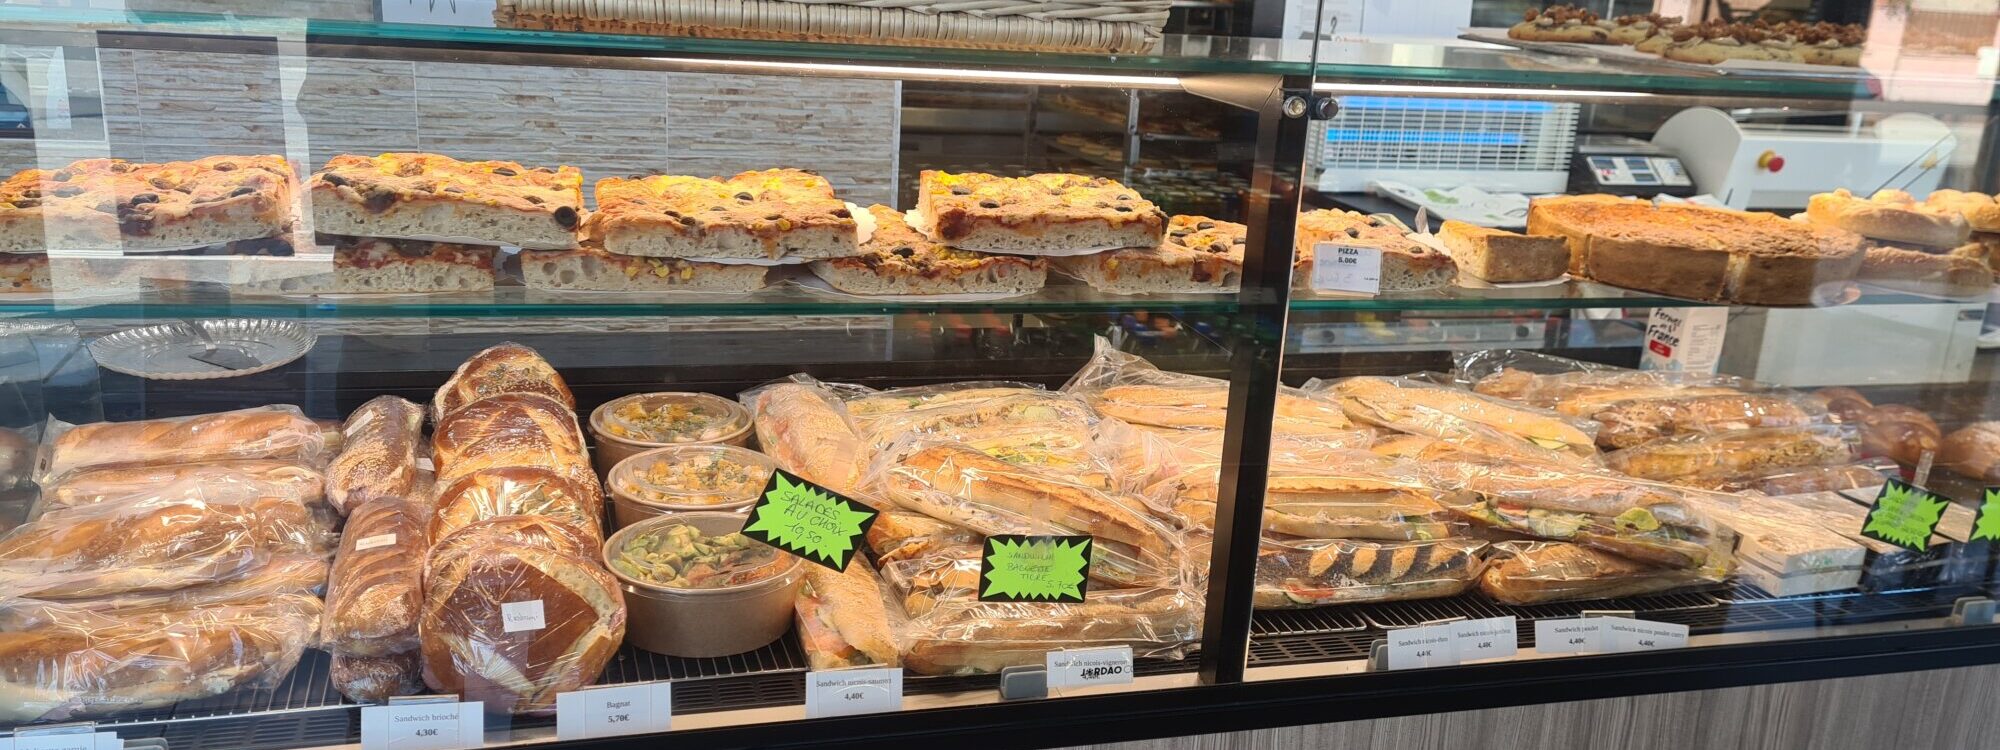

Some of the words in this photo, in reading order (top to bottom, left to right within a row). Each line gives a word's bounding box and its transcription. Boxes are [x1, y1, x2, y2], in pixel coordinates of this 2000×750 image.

[1648, 324, 1680, 347] France
[780, 491, 840, 521] SALADES
[784, 504, 806, 521] AU
[810, 516, 848, 536] CHOIX
[1554, 625, 1581, 633] Sandwich
[1611, 624, 1636, 633] Sandwich
[1457, 630, 1479, 638] Sandwich
[1398, 639, 1421, 647] Sandwich
[816, 680, 847, 688] Sandwich
[844, 693, 864, 701] 4,40€
[606, 701, 631, 709] Bagnat
[394, 714, 431, 723] Sandwich
[608, 714, 630, 723] 5,70€
[415, 728, 439, 737] 4,30€
